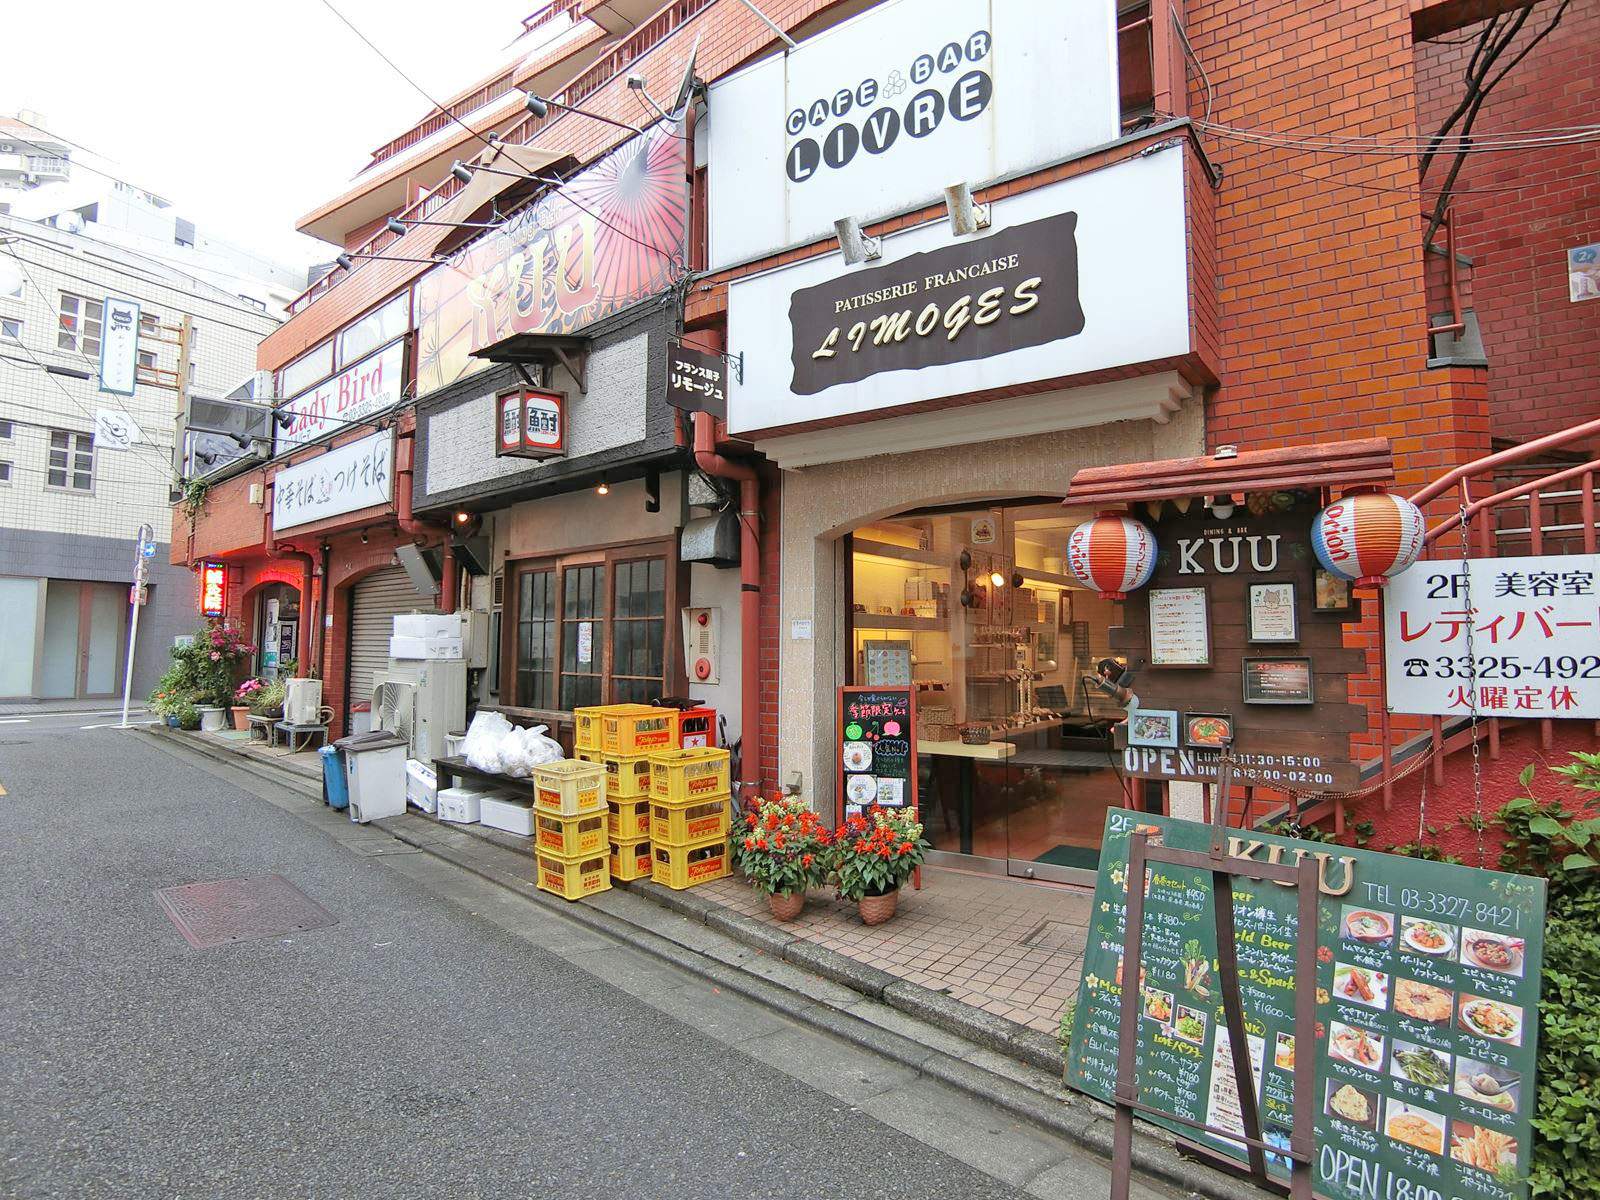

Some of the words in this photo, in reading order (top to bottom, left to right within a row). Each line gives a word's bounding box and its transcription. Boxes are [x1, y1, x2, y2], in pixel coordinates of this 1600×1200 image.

[786, 78, 879, 135] CAFE
[910, 30, 992, 84] BAR
[786, 70, 993, 183] LIVRE
[834, 280, 917, 314] PATISSERIE
[924, 253, 1019, 290] FRANCAISE
[812, 276, 1042, 360] LIMOGES
[672, 373, 723, 399] リモージュ
[675, 360, 720, 381] フランス菓子
[289, 390, 331, 437] Lady
[337, 353, 383, 413] Bird
[334, 447, 389, 494] つけそば
[1324, 506, 1350, 560] Orion
[1071, 531, 1089, 580] Orion
[1177, 535, 1280, 573] KUU
[1426, 574, 1472, 599] 2F
[1495, 570, 1595, 598] 美容室
[1400, 605, 1600, 644] レディバー
[1447, 685, 1579, 711] 火曜定休
[1124, 746, 1195, 776] OPEN
[1197, 752, 1238, 762] LUN
[1239, 754, 1320, 767] 11:30-15:00
[1110, 814, 1133, 832] 2F
[1232, 891, 1254, 902] eer
[1233, 904, 1277, 920] リオン樽生
[1362, 881, 1395, 906] TEL
[1401, 888, 1521, 930] 03-3327-8421
[1235, 929, 1256, 942] rld
[1261, 935, 1293, 950] Beer
[1258, 969, 1296, 990] Spark
[1468, 1046, 1508, 1066] エビマヨ
[1320, 1144, 1380, 1200] OPEN
